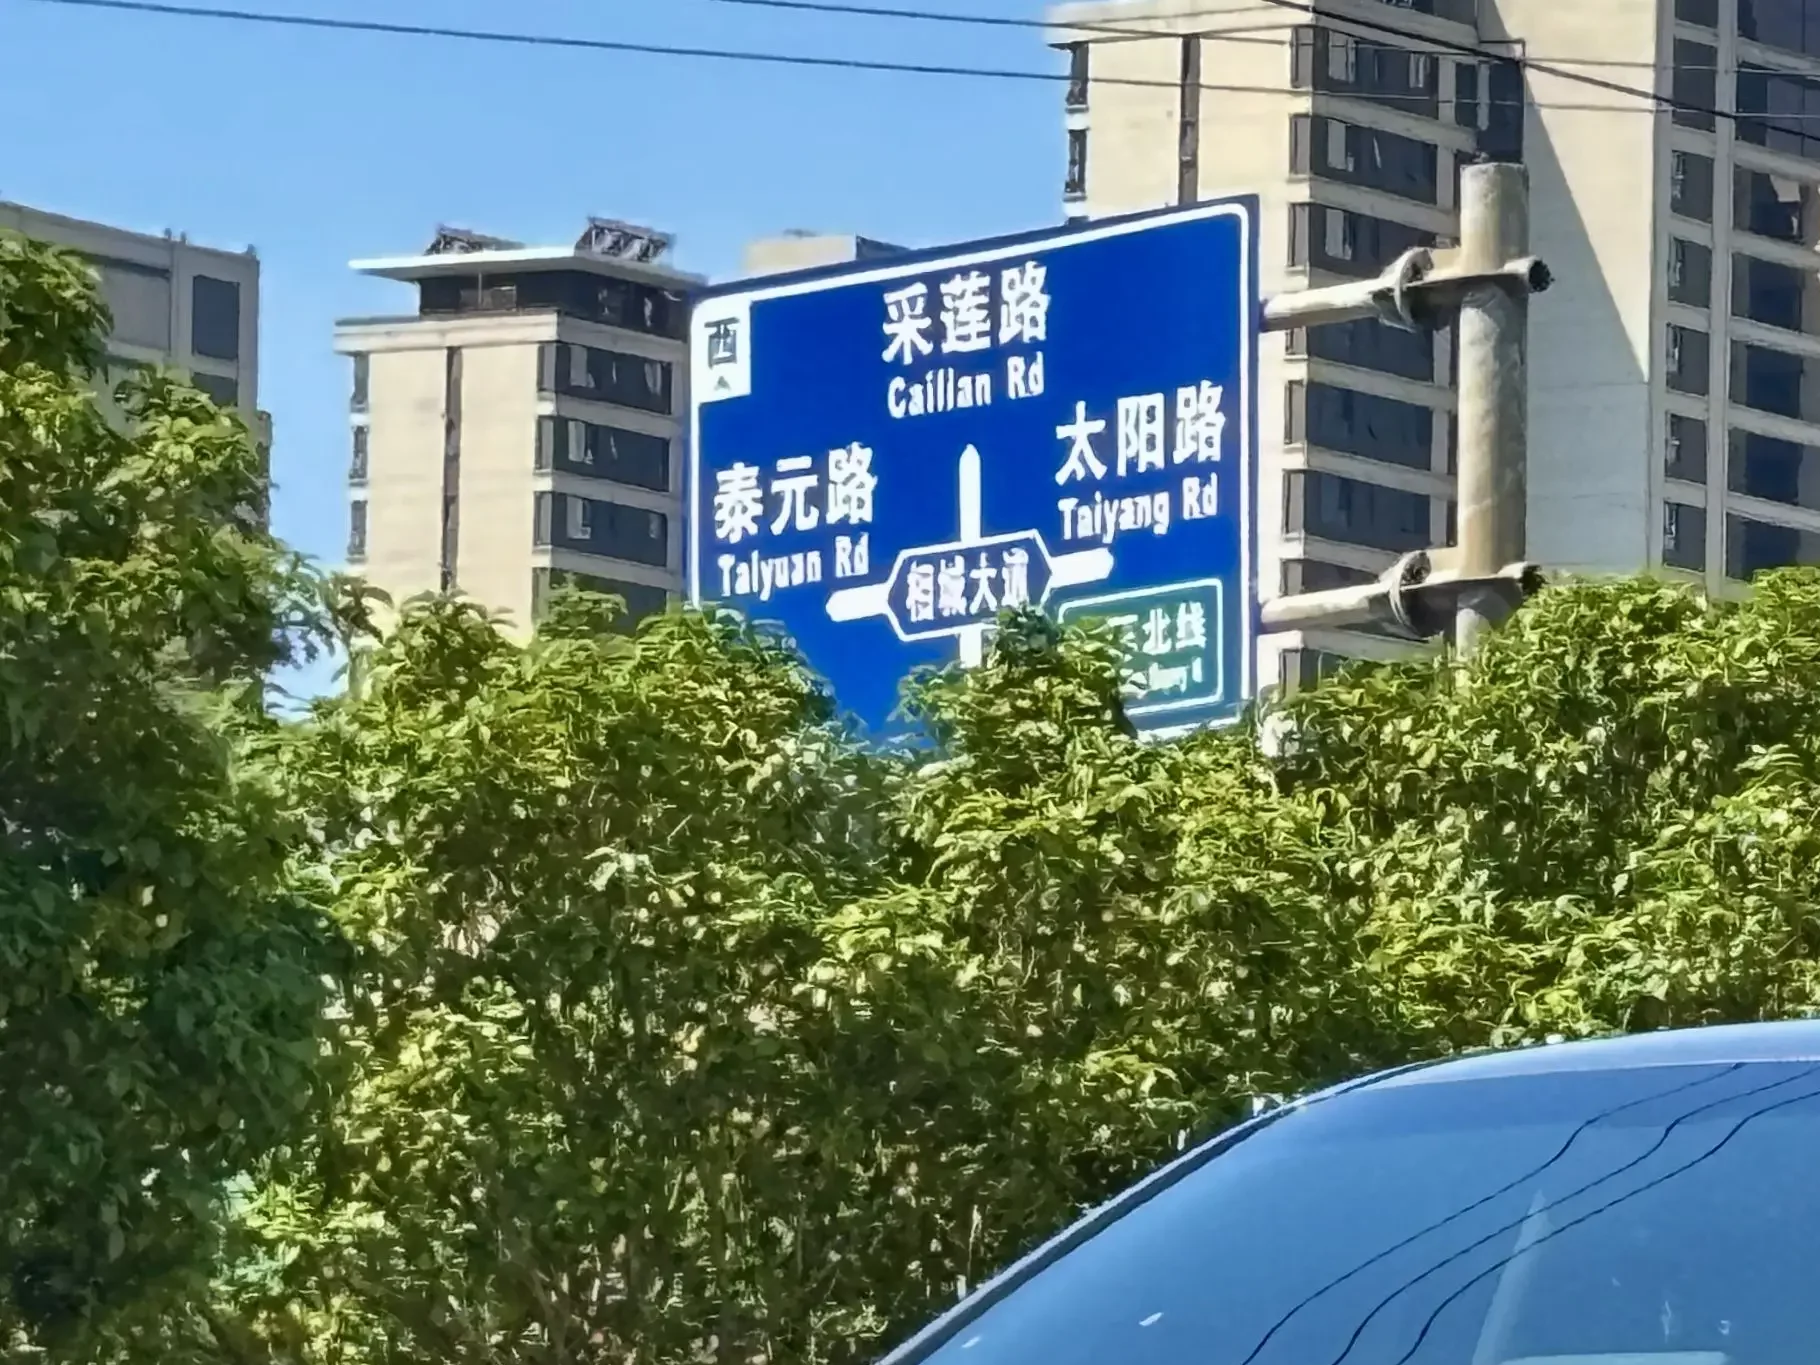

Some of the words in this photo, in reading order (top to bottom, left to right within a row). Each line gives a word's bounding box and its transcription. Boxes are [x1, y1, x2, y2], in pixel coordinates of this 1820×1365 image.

[704, 316, 740, 370] 西
[881, 260, 1051, 366] 采莲路
[1007, 350, 1045, 400] Rd
[1055, 379, 1226, 486] 太阳路
[713, 441, 878, 544] 泰元路
[1057, 490, 1170, 544] Taiyang
[1182, 472, 1218, 520] Rd
[835, 532, 869, 578] Rd
